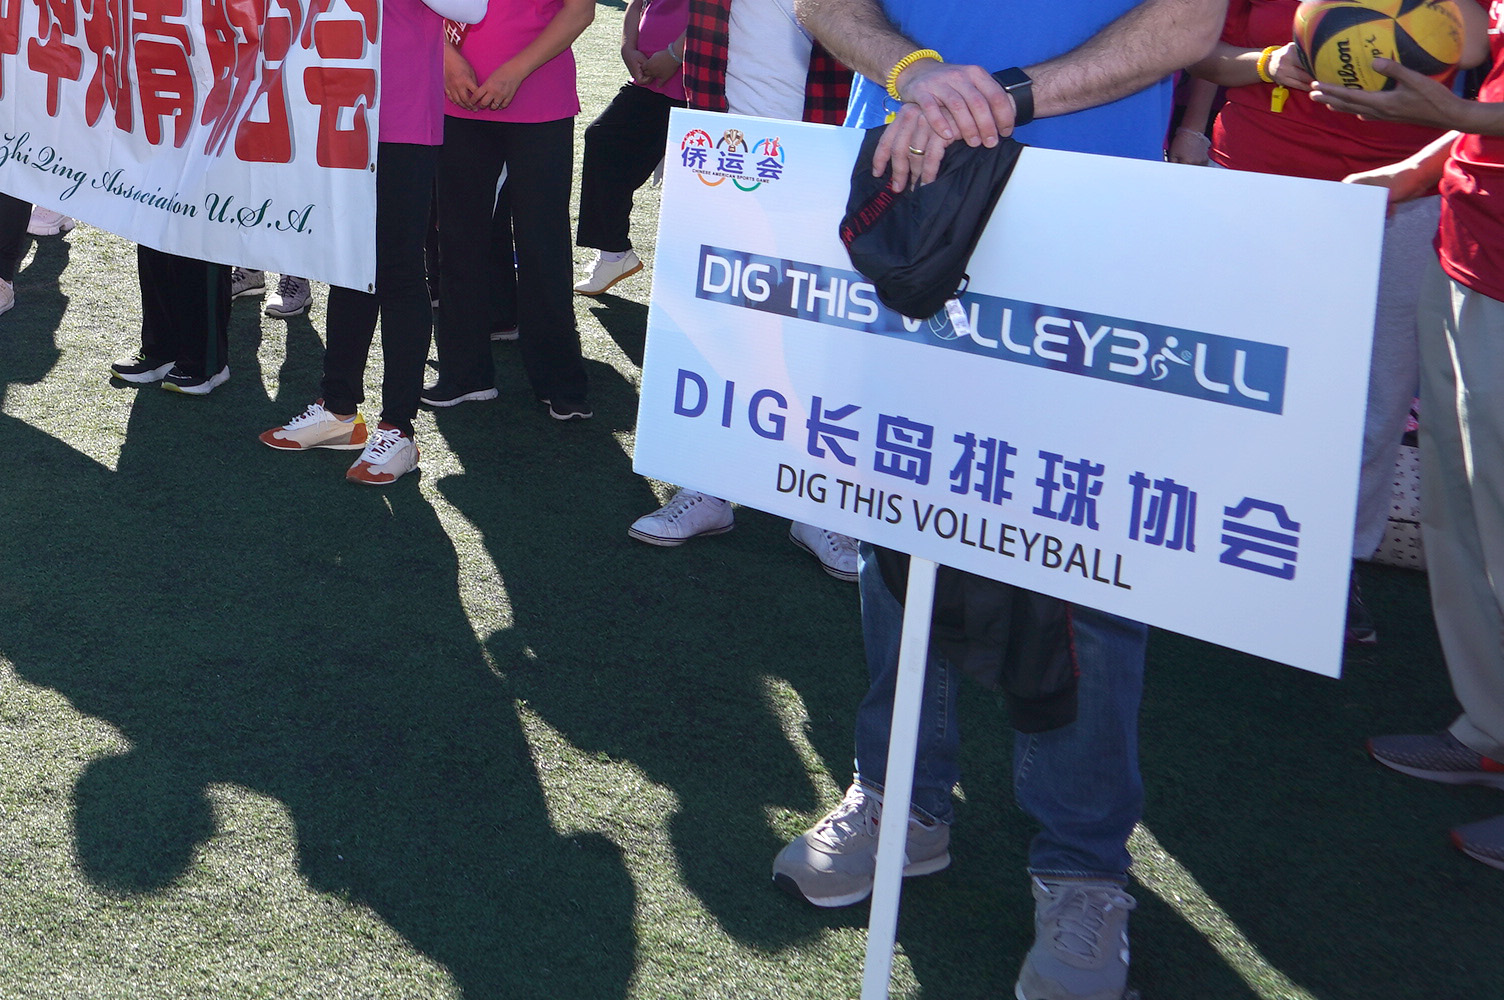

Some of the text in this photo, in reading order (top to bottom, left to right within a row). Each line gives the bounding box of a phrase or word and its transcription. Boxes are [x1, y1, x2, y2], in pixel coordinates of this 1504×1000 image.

[681, 146, 784, 180] 侨运会
[691, 168, 711, 176] CHINESE
[712, 171, 736, 179] AMERICAN
[736, 174, 755, 182] SPORTS
[204, 192, 316, 235] U.S.A.
[702, 253, 771, 302] DIG
[786, 268, 880, 324] THIS
[776, 463, 1133, 591] DIG THIS VOLLEYBALL
